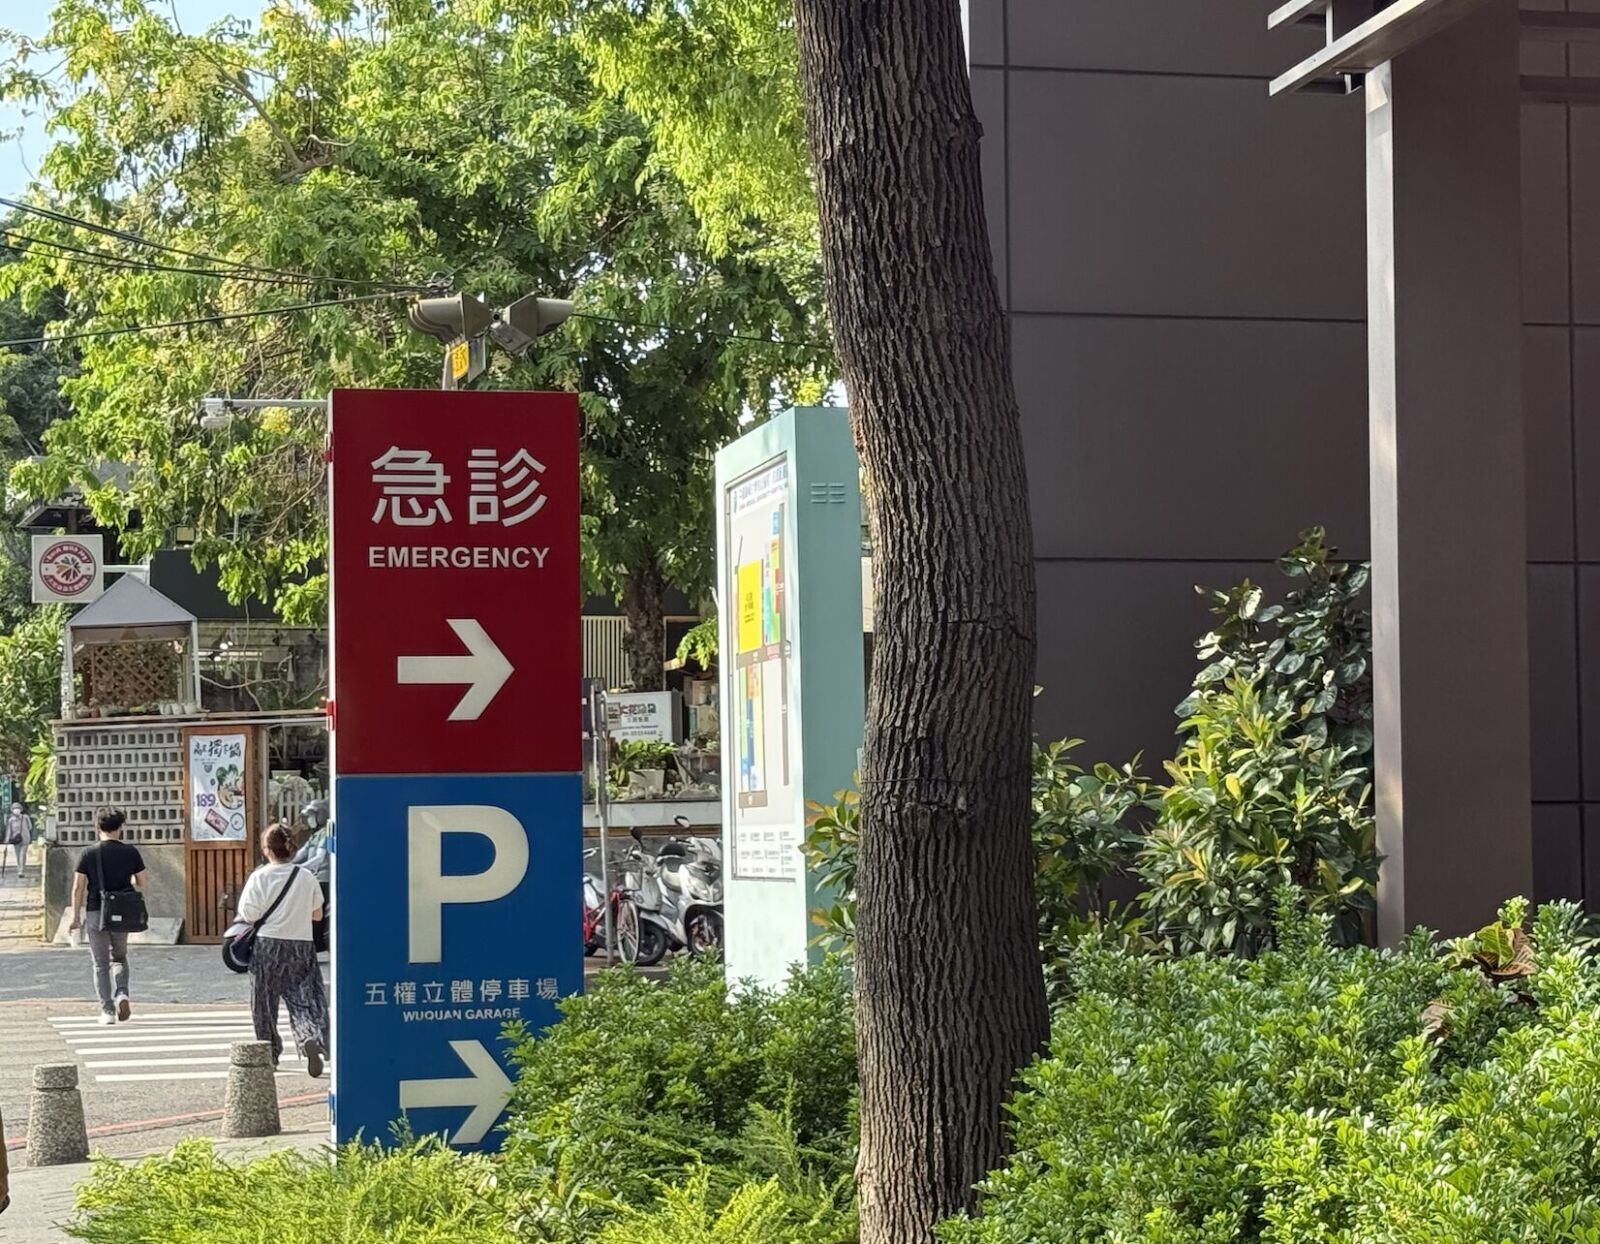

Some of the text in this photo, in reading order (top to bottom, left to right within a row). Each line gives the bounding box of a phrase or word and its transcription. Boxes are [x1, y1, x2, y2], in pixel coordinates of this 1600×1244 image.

[371, 445, 548, 527] 急診
[368, 546, 550, 569] EMERGENCY
[196, 794, 216, 808] 189
[407, 805, 529, 964] P
[364, 977, 560, 1006] 五權立體停車場
[403, 1007, 521, 1023] WUQUAN GARAGE
